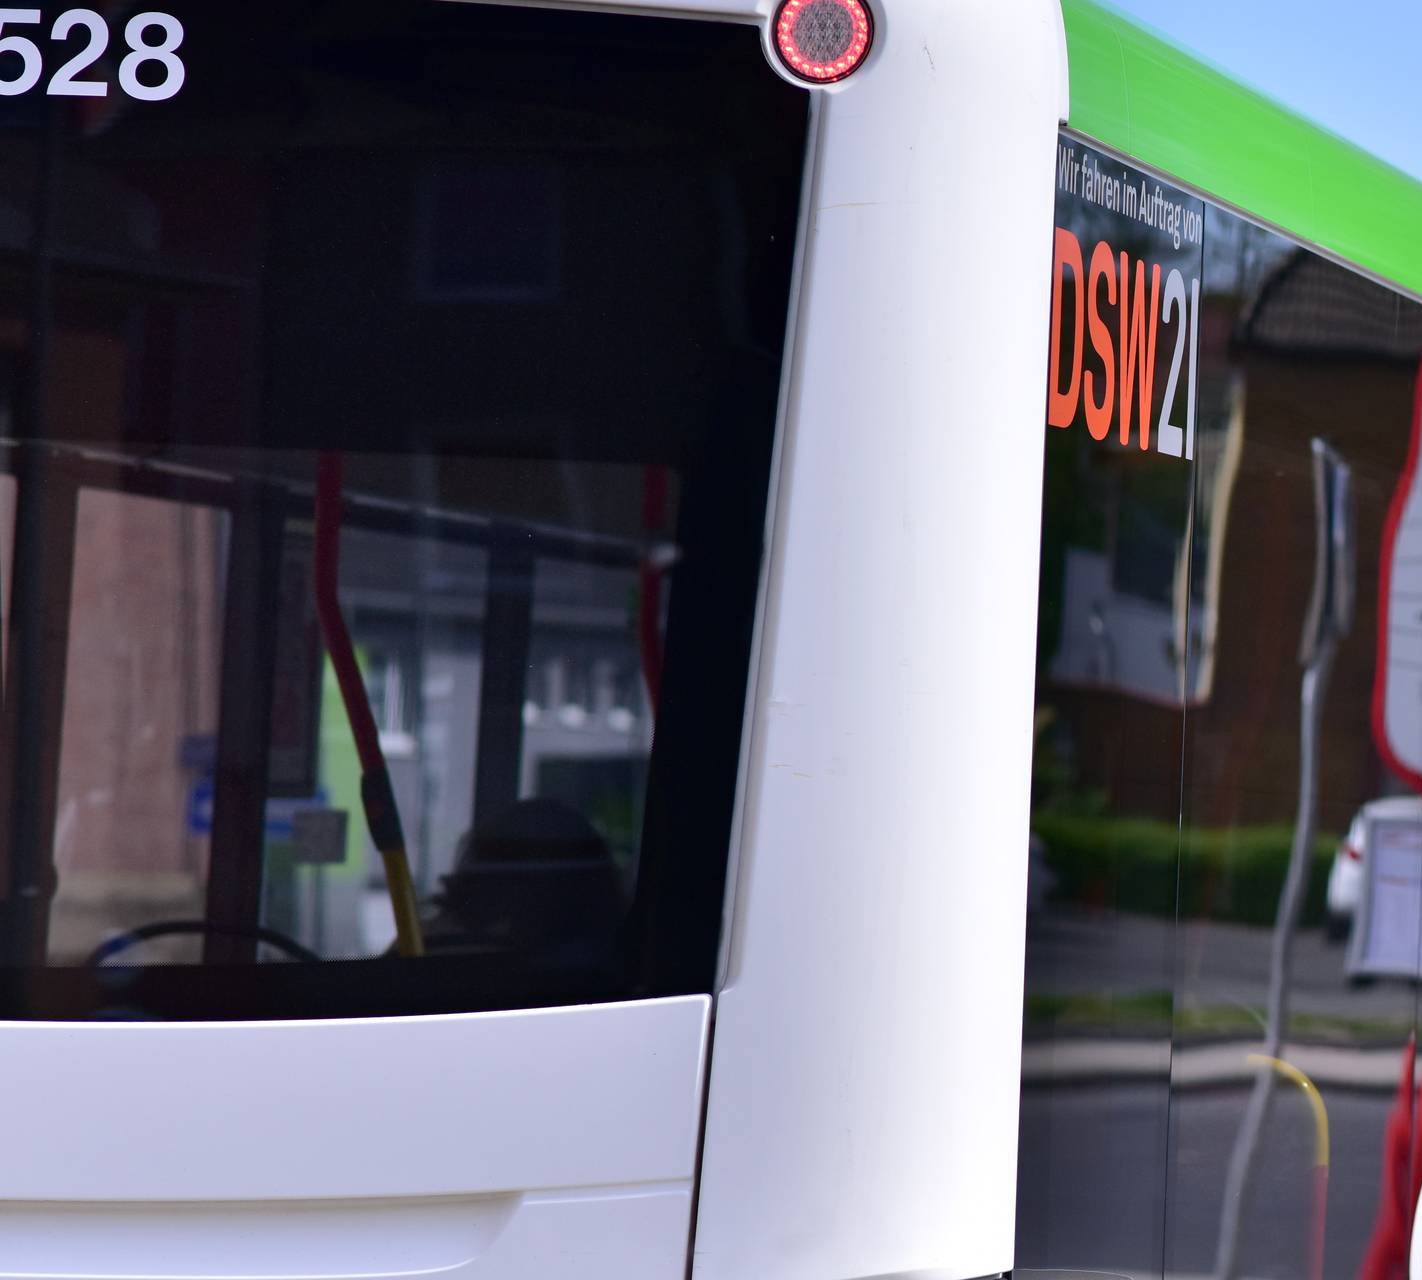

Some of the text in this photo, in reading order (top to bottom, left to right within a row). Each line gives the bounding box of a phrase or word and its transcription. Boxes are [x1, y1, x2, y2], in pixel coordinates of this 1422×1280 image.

[0, 8, 186, 101] 528
[1057, 143, 1202, 250] Wir fahren im Auftrag von
[1048, 226, 1200, 461] DSW21
